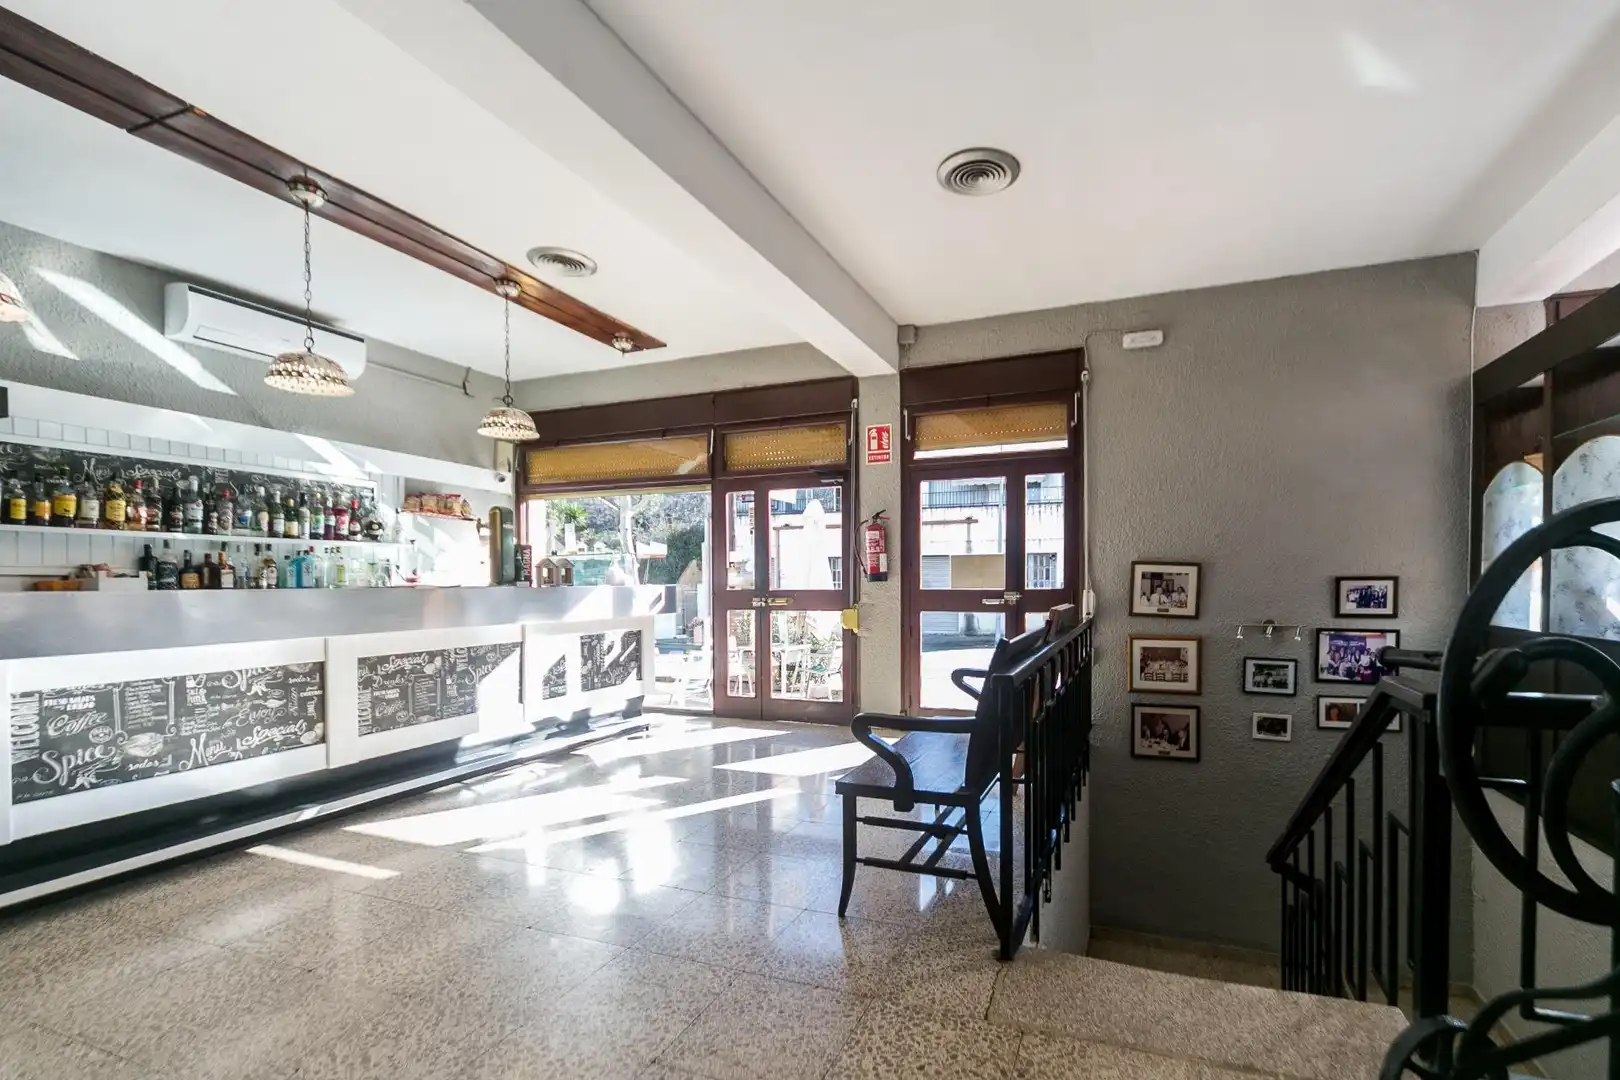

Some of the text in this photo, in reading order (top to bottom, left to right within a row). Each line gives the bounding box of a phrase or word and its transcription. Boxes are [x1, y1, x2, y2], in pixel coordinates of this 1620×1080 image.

[11, 692, 40, 765] WELCOME
[46, 710, 107, 737] Coffee
[241, 718, 307, 749] Specials
[33, 744, 117, 786] Spice
[179, 732, 232, 770] Menu
